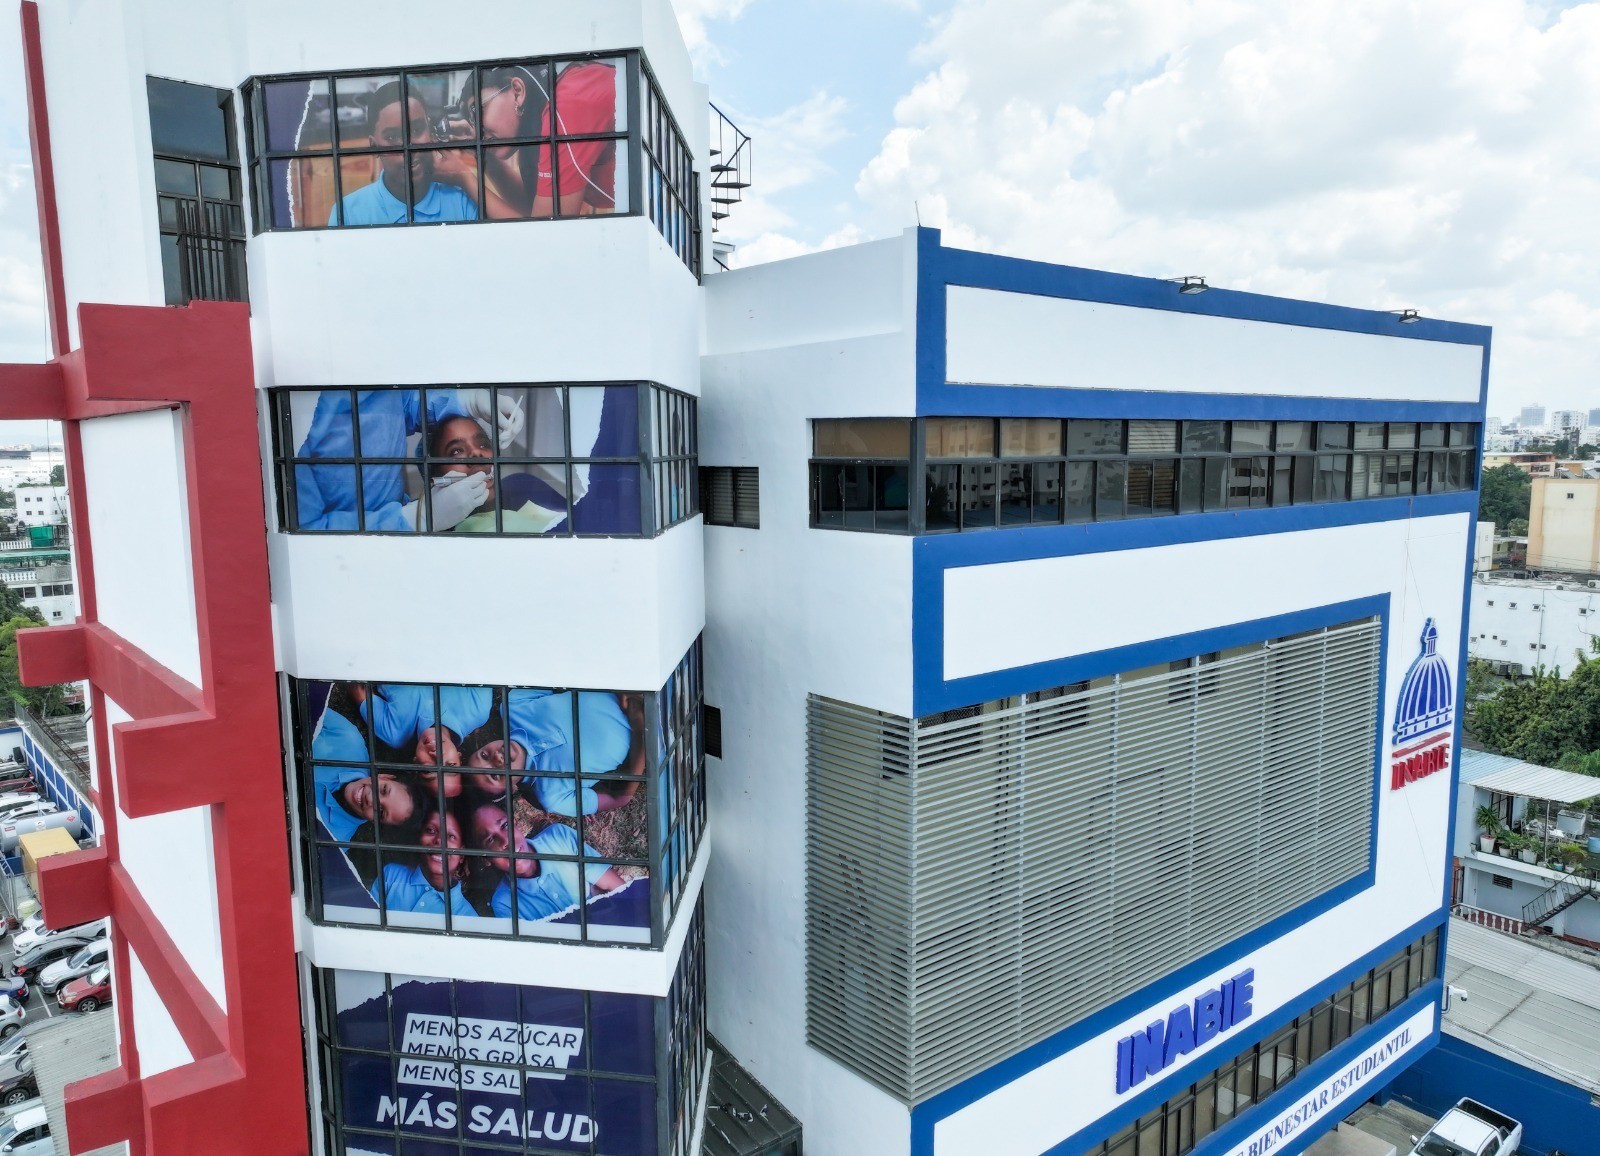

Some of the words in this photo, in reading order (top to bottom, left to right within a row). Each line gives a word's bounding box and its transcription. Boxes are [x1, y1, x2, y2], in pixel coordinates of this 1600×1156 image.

[1391, 743, 1450, 791] INABIE
[407, 1042, 480, 1061] MENOS
[409, 1019, 482, 1040] MENOS
[487, 1025, 577, 1049] AZÚCAR
[1116, 967, 1254, 1095] INABIE
[403, 1063, 475, 1085] MENOS
[481, 1071, 520, 1090] SAL
[1248, 1089, 1329, 1156] BIENESTAR
[1330, 1027, 1412, 1101] ESTUDIANTIL
[376, 1091, 458, 1130] MÁS
[467, 1104, 599, 1143] SALUD
